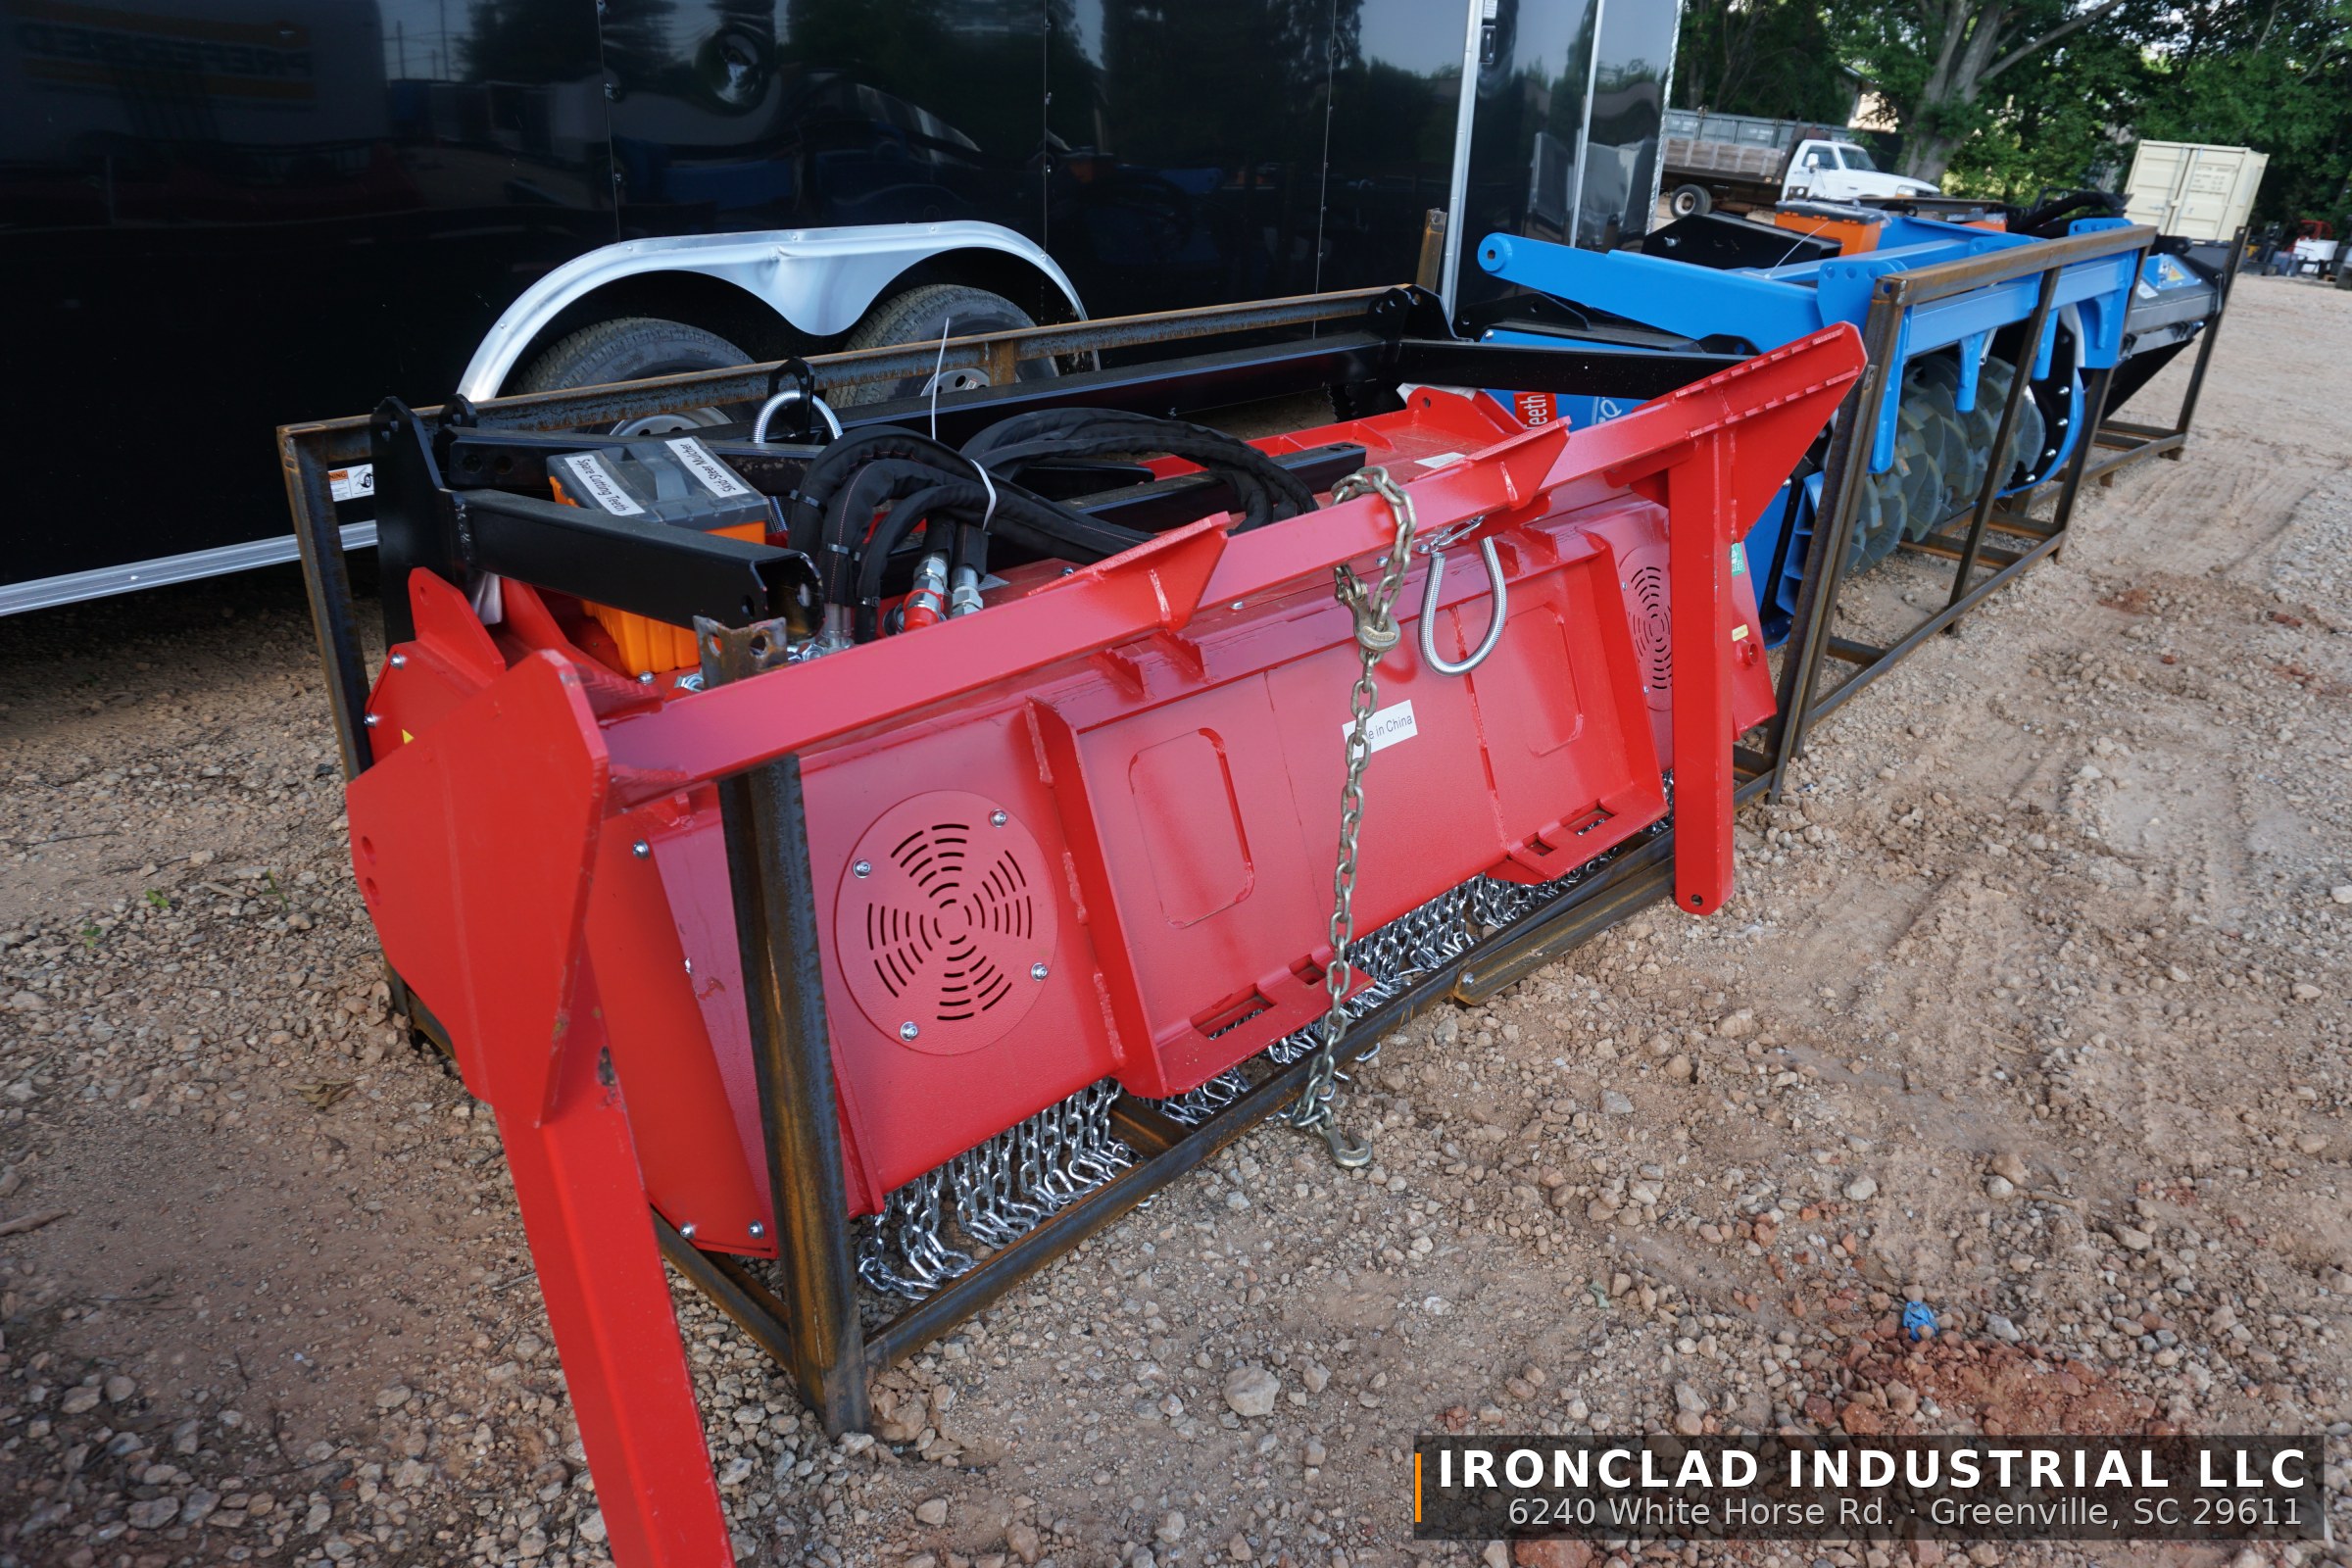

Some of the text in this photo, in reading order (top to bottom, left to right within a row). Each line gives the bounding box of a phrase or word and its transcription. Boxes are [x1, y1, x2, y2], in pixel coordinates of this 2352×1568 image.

[576, 459, 630, 512] Spare Cutting Teeth
[680, 443, 737, 492] Skid-Steer Mulcher
[1375, 724, 1385, 738] in
[1386, 715, 1413, 732] China
